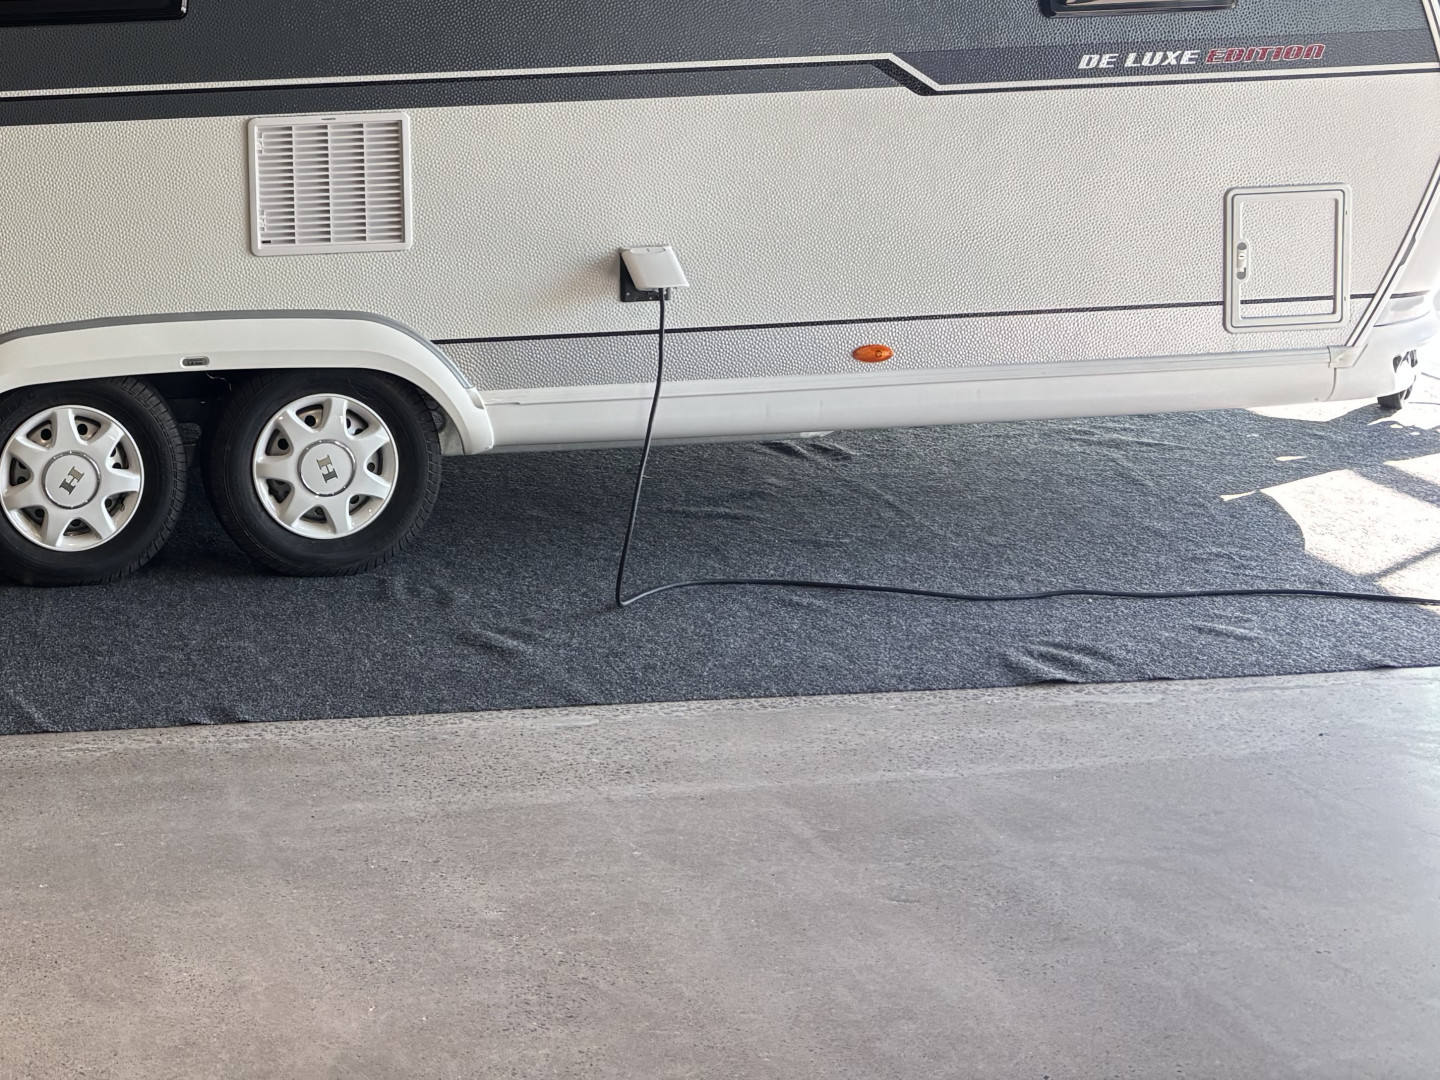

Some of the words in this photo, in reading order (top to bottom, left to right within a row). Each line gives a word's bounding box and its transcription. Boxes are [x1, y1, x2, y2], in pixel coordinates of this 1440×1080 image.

[1077, 53, 1118, 69] DE
[1124, 50, 1201, 67] LUXE
[1205, 43, 1327, 64] EDITION
[58, 465, 85, 495] H
[316, 454, 339, 484] H
